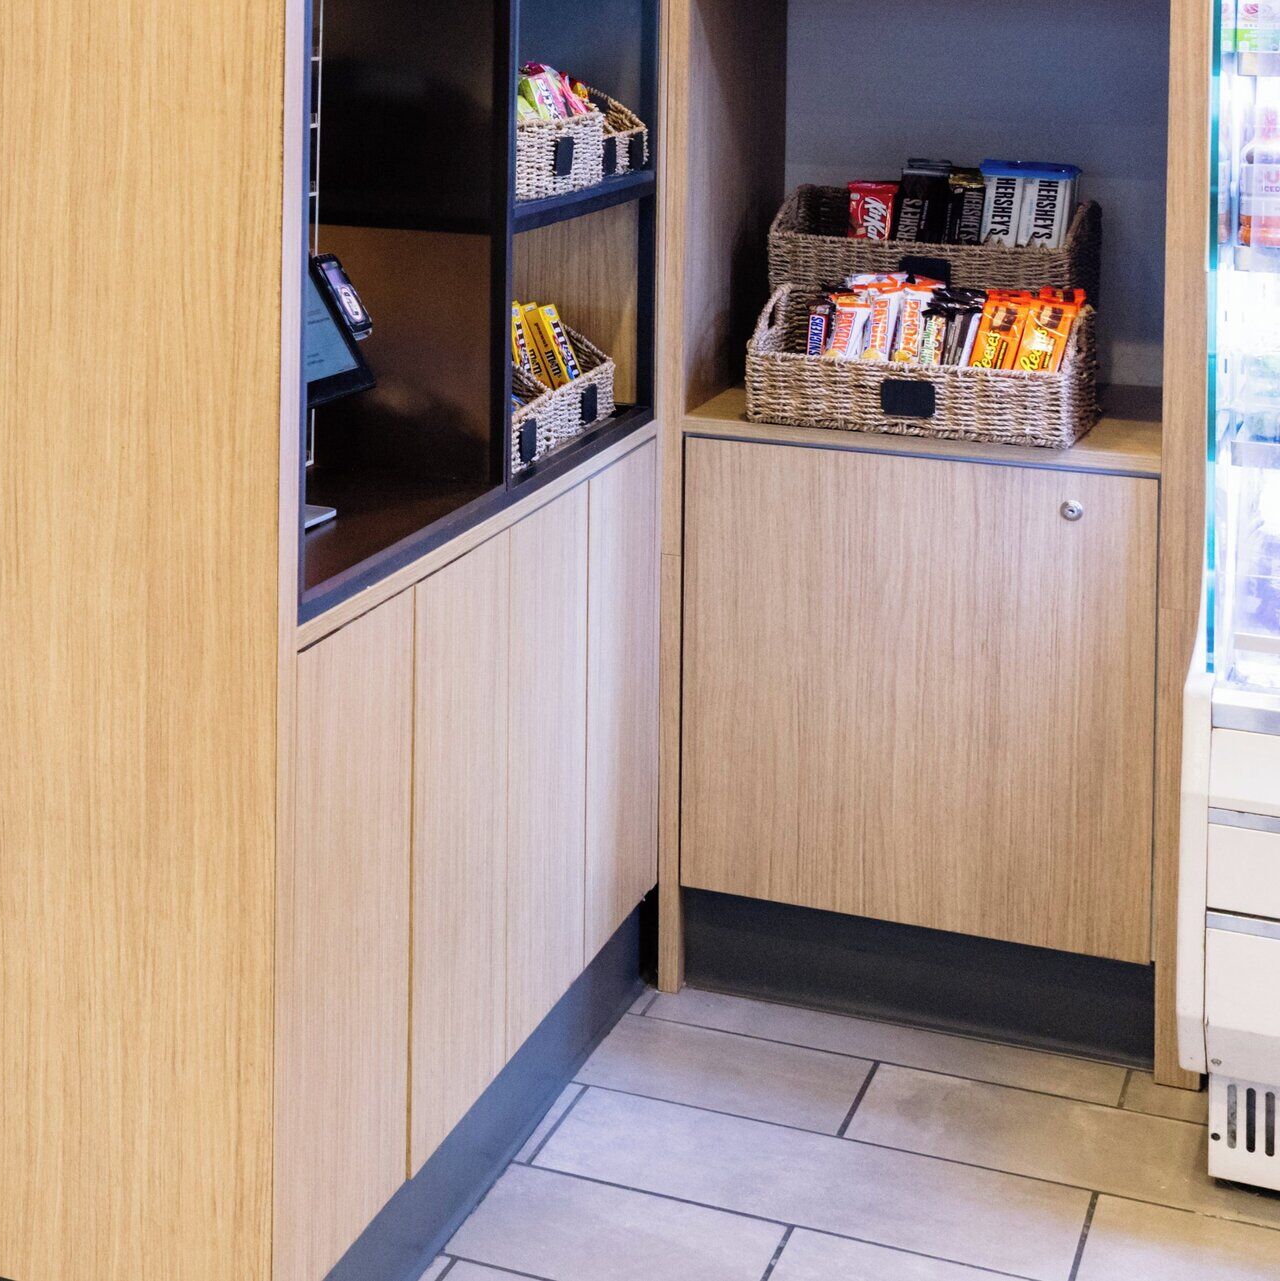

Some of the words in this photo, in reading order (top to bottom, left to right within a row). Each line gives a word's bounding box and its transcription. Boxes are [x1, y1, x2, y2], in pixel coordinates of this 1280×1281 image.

[896, 198, 922, 241] RSHEY'S
[990, 178, 1017, 236] HERSHEY'S
[1033, 180, 1059, 240] HERSHEY'S
[809, 316, 824, 356] SNICKERS
[832, 311, 856, 353] PAYDAY
